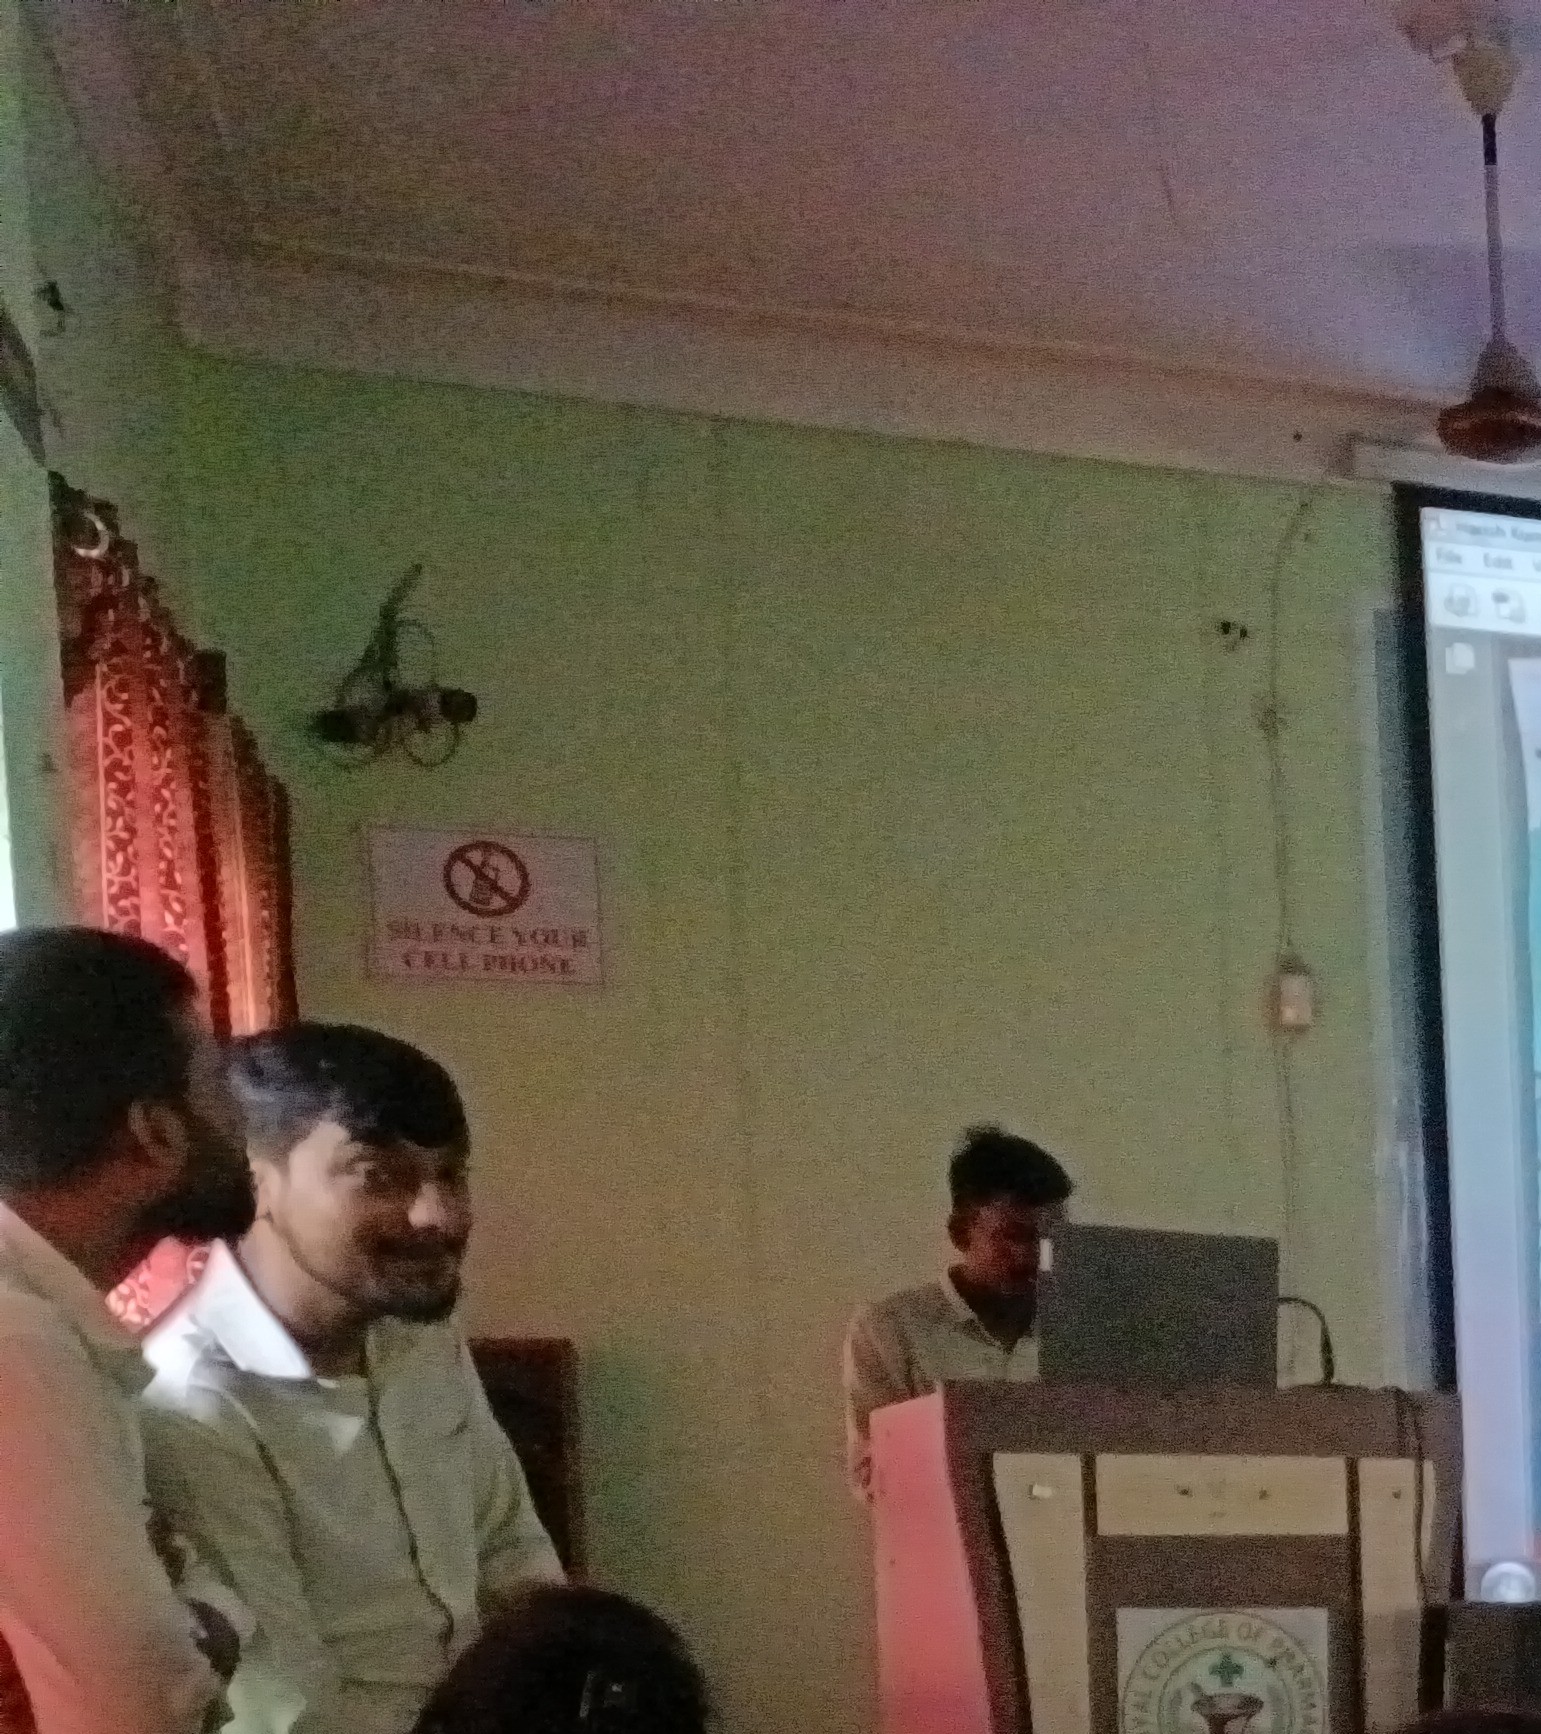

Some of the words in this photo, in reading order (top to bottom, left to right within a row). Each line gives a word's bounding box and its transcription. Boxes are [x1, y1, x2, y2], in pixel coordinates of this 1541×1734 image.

[386, 919, 504, 945] SILENCE
[511, 925, 591, 949] YOUR
[402, 949, 473, 972] CELL
[482, 952, 578, 977] PHONE
